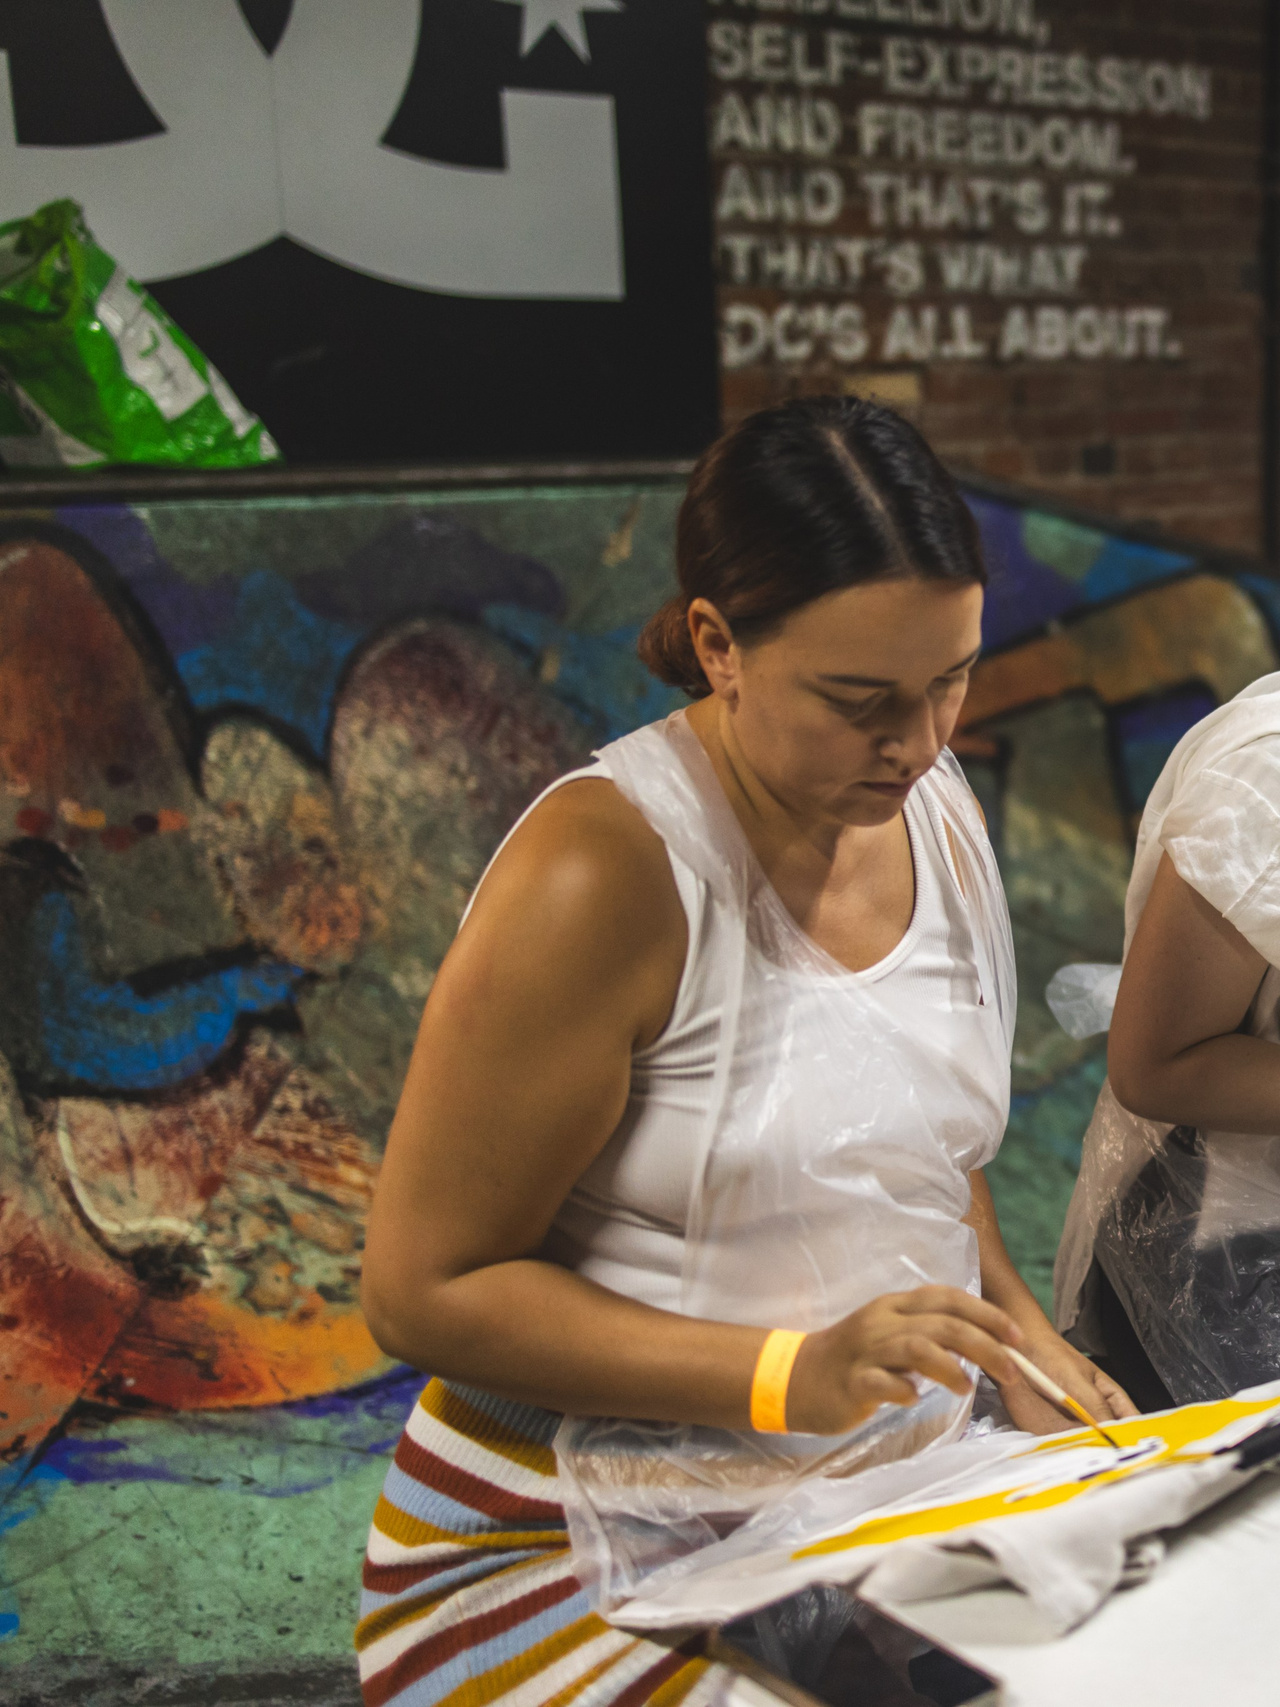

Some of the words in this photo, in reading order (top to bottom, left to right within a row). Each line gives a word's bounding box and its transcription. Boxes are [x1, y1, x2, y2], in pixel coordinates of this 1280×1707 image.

[706, 18, 1212, 120] SELF-EXPRESSION
[711, 92, 843, 157] AND
[857, 102, 1138, 174] FREEDOM.
[716, 164, 844, 227] AND
[860, 172, 1050, 235] THAT'S
[718, 235, 925, 297] THAT'S
[936, 244, 1090, 298] WHAT
[721, 302, 869, 368] DC'S
[1000, 305, 1184, 361] ABOUT.
